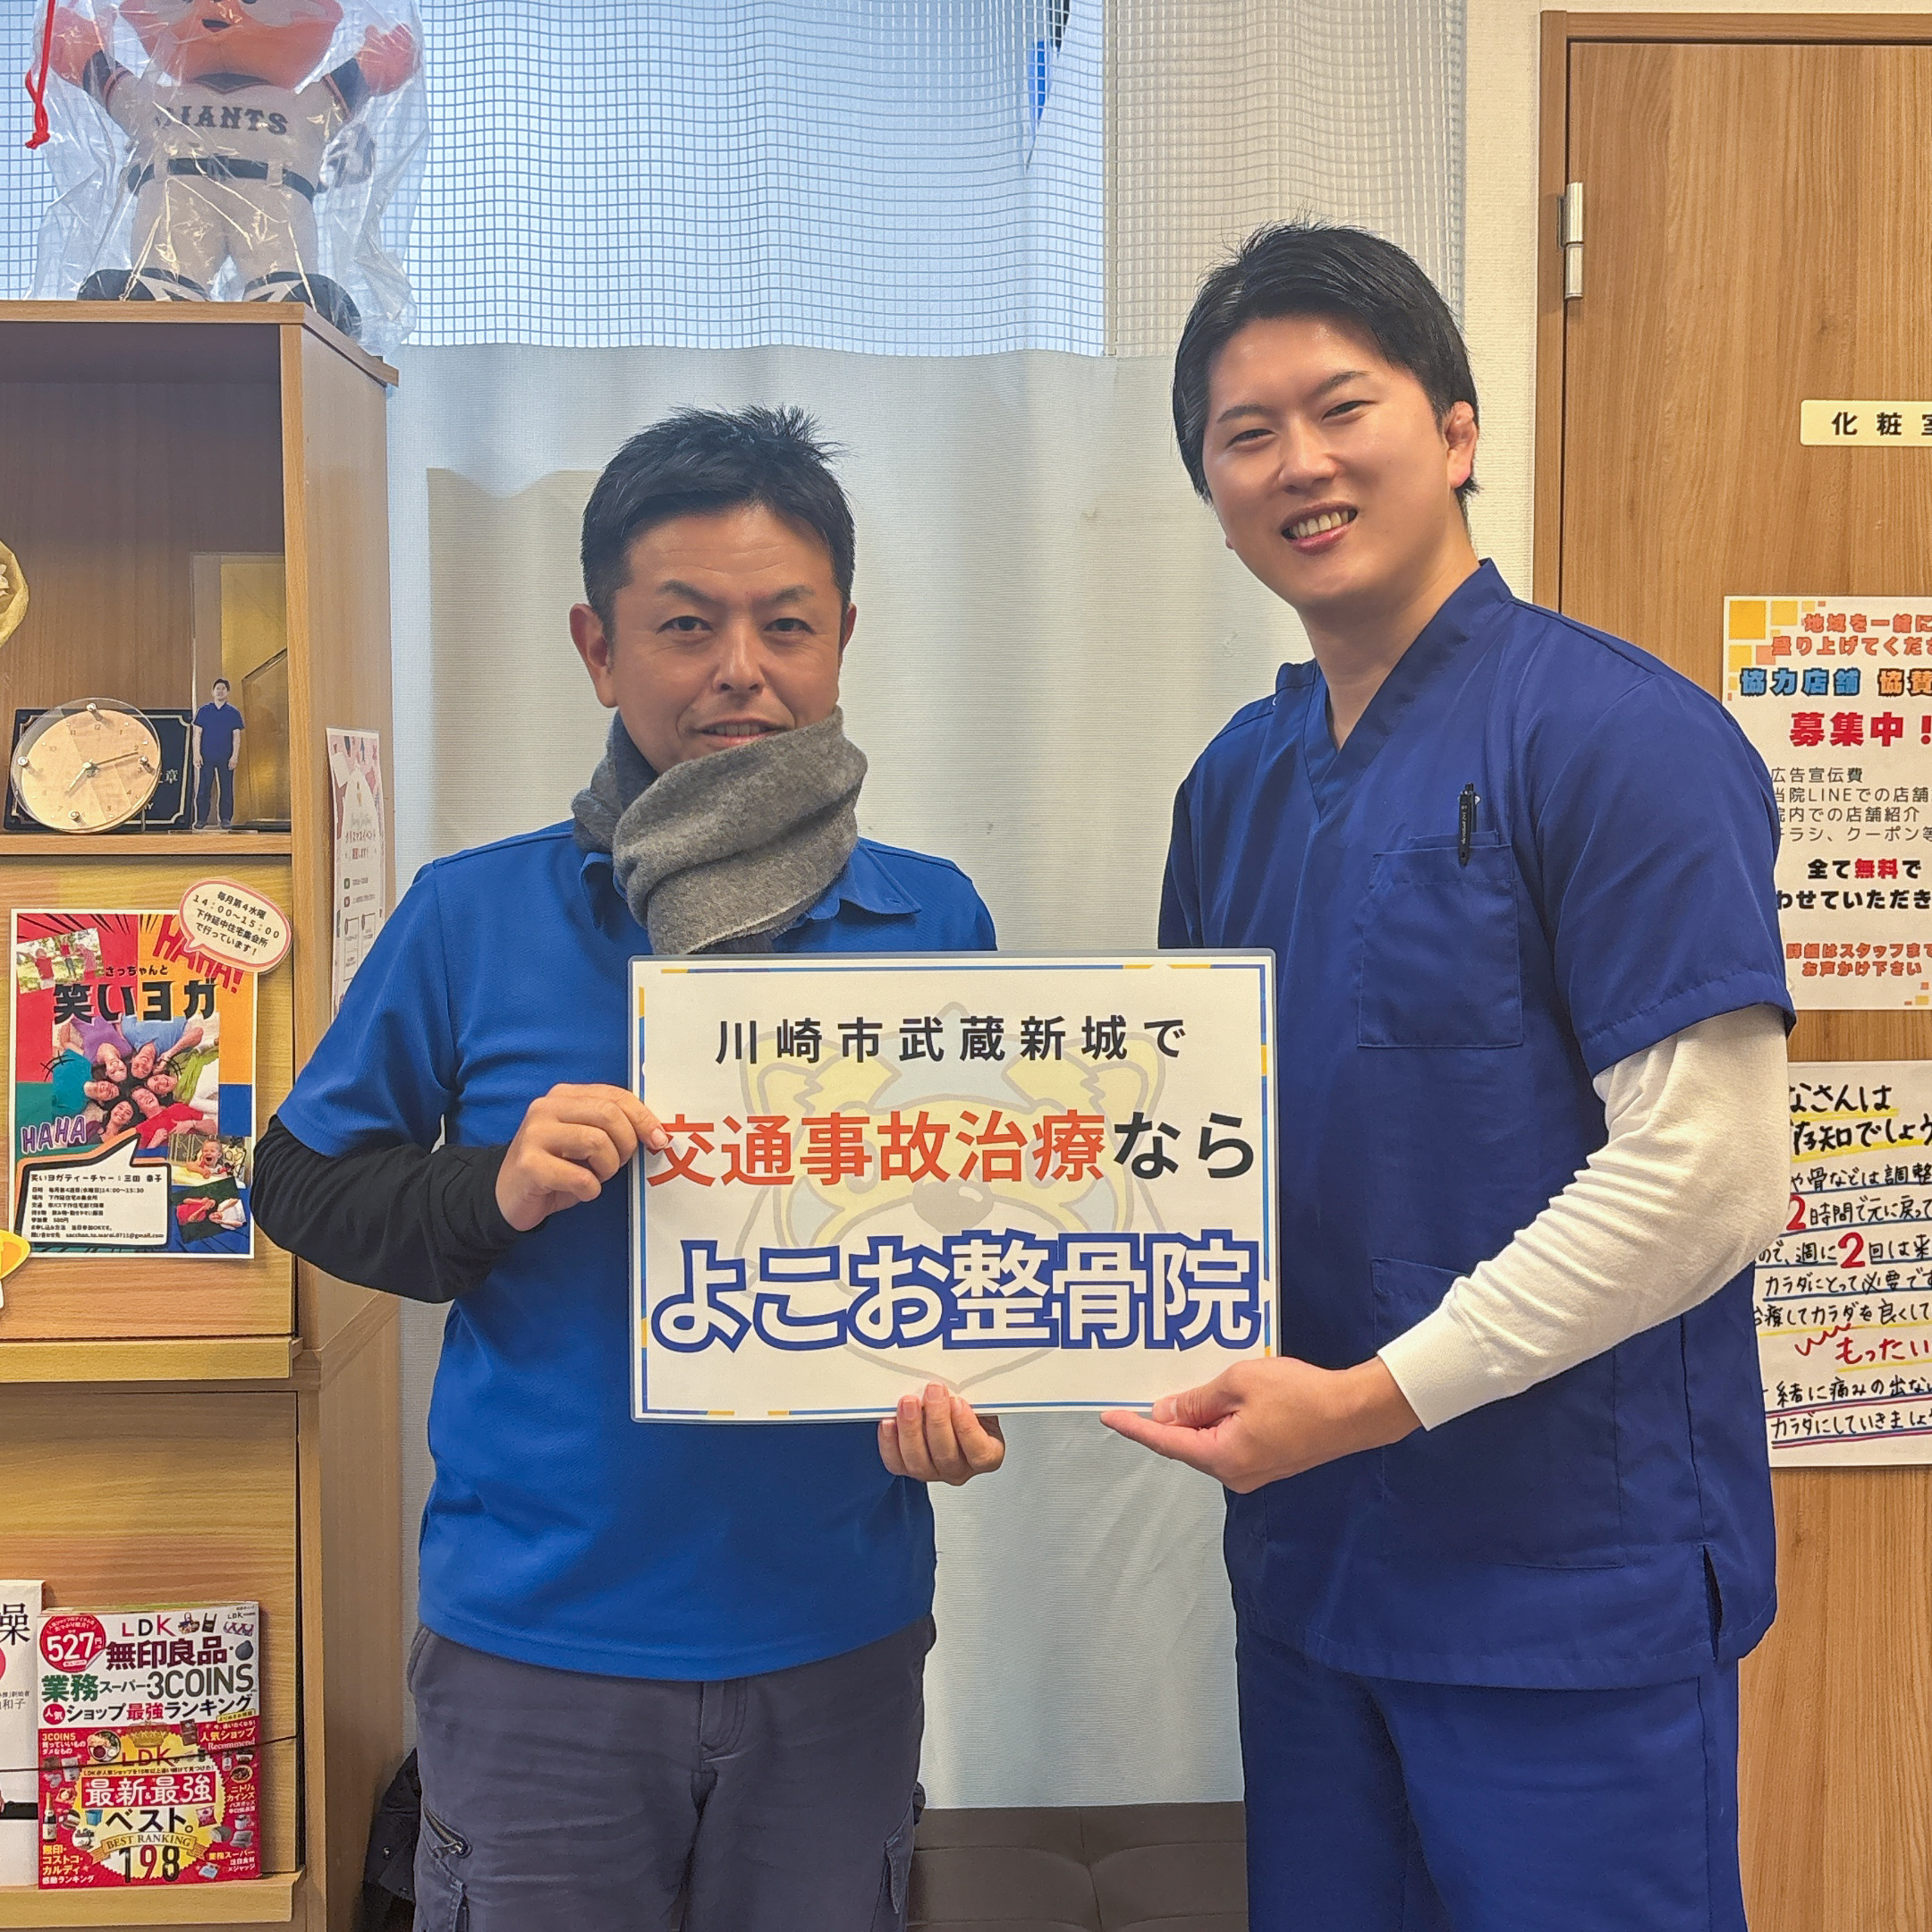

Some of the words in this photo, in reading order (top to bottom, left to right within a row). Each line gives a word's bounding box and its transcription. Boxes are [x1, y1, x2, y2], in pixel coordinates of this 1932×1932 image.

[1803, 613, 1932, 633] 地域を一緒に
[1739, 666, 1860, 697] 協力店舗
[1772, 767, 1863, 784] 広告宣伝費
[1775, 787, 1932, 803] 当院LINEでの店舗
[1781, 826, 1932, 843] ラシ、クーポン等
[1808, 859, 1922, 879] 全て無料で
[1777, 889, 1931, 911] わせていただき
[105, 964, 169, 978] さっちゃんと
[1802, 961, 1922, 978] お声かけ下さい
[53, 978, 220, 1025] 笑いヨガ
[716, 1014, 1187, 1065] 川崎市武蔵新城で
[21, 1116, 87, 1153] HAHA
[646, 1108, 1255, 1188] 交通事故治療なら
[1790, 1113, 1932, 1157] 存知でしょう
[650, 1228, 1263, 1352] よこお整骨院
[1835, 1336, 1929, 1365] もったい
[1763, 1374, 1932, 1409] 緒に痛みの出な
[1771, 1408, 1932, 1439] カラダにしていきましょ
[122, 1614, 176, 1638] LDK
[46, 1631, 95, 1662] 527
[106, 1836, 134, 1850] BEST
[137, 1834, 191, 1848] RANKING
[119, 1843, 180, 1884] 198
